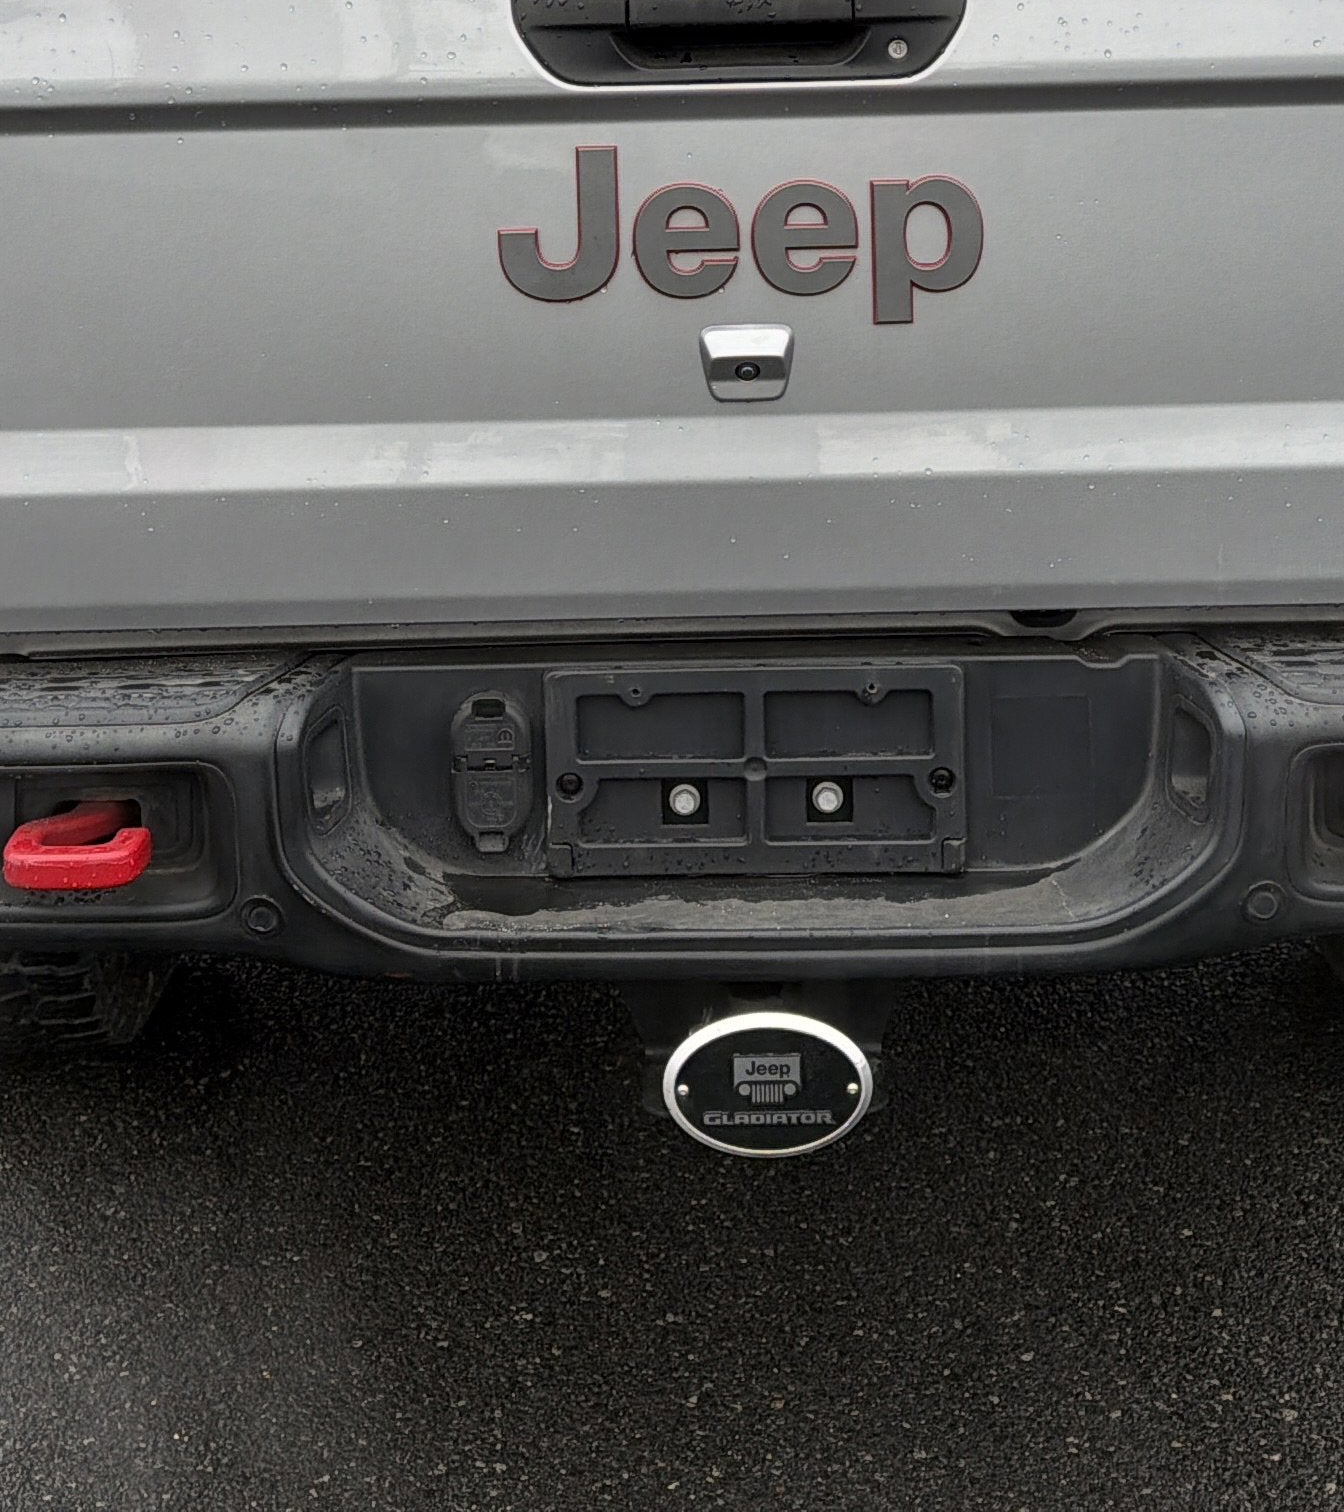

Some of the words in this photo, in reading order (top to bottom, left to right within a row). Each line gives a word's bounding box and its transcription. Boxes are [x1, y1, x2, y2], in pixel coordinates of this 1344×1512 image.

[497, 144, 985, 325] Jeep
[745, 1061, 791, 1078] Jeep
[703, 1110, 838, 1126] GLADIATOR
